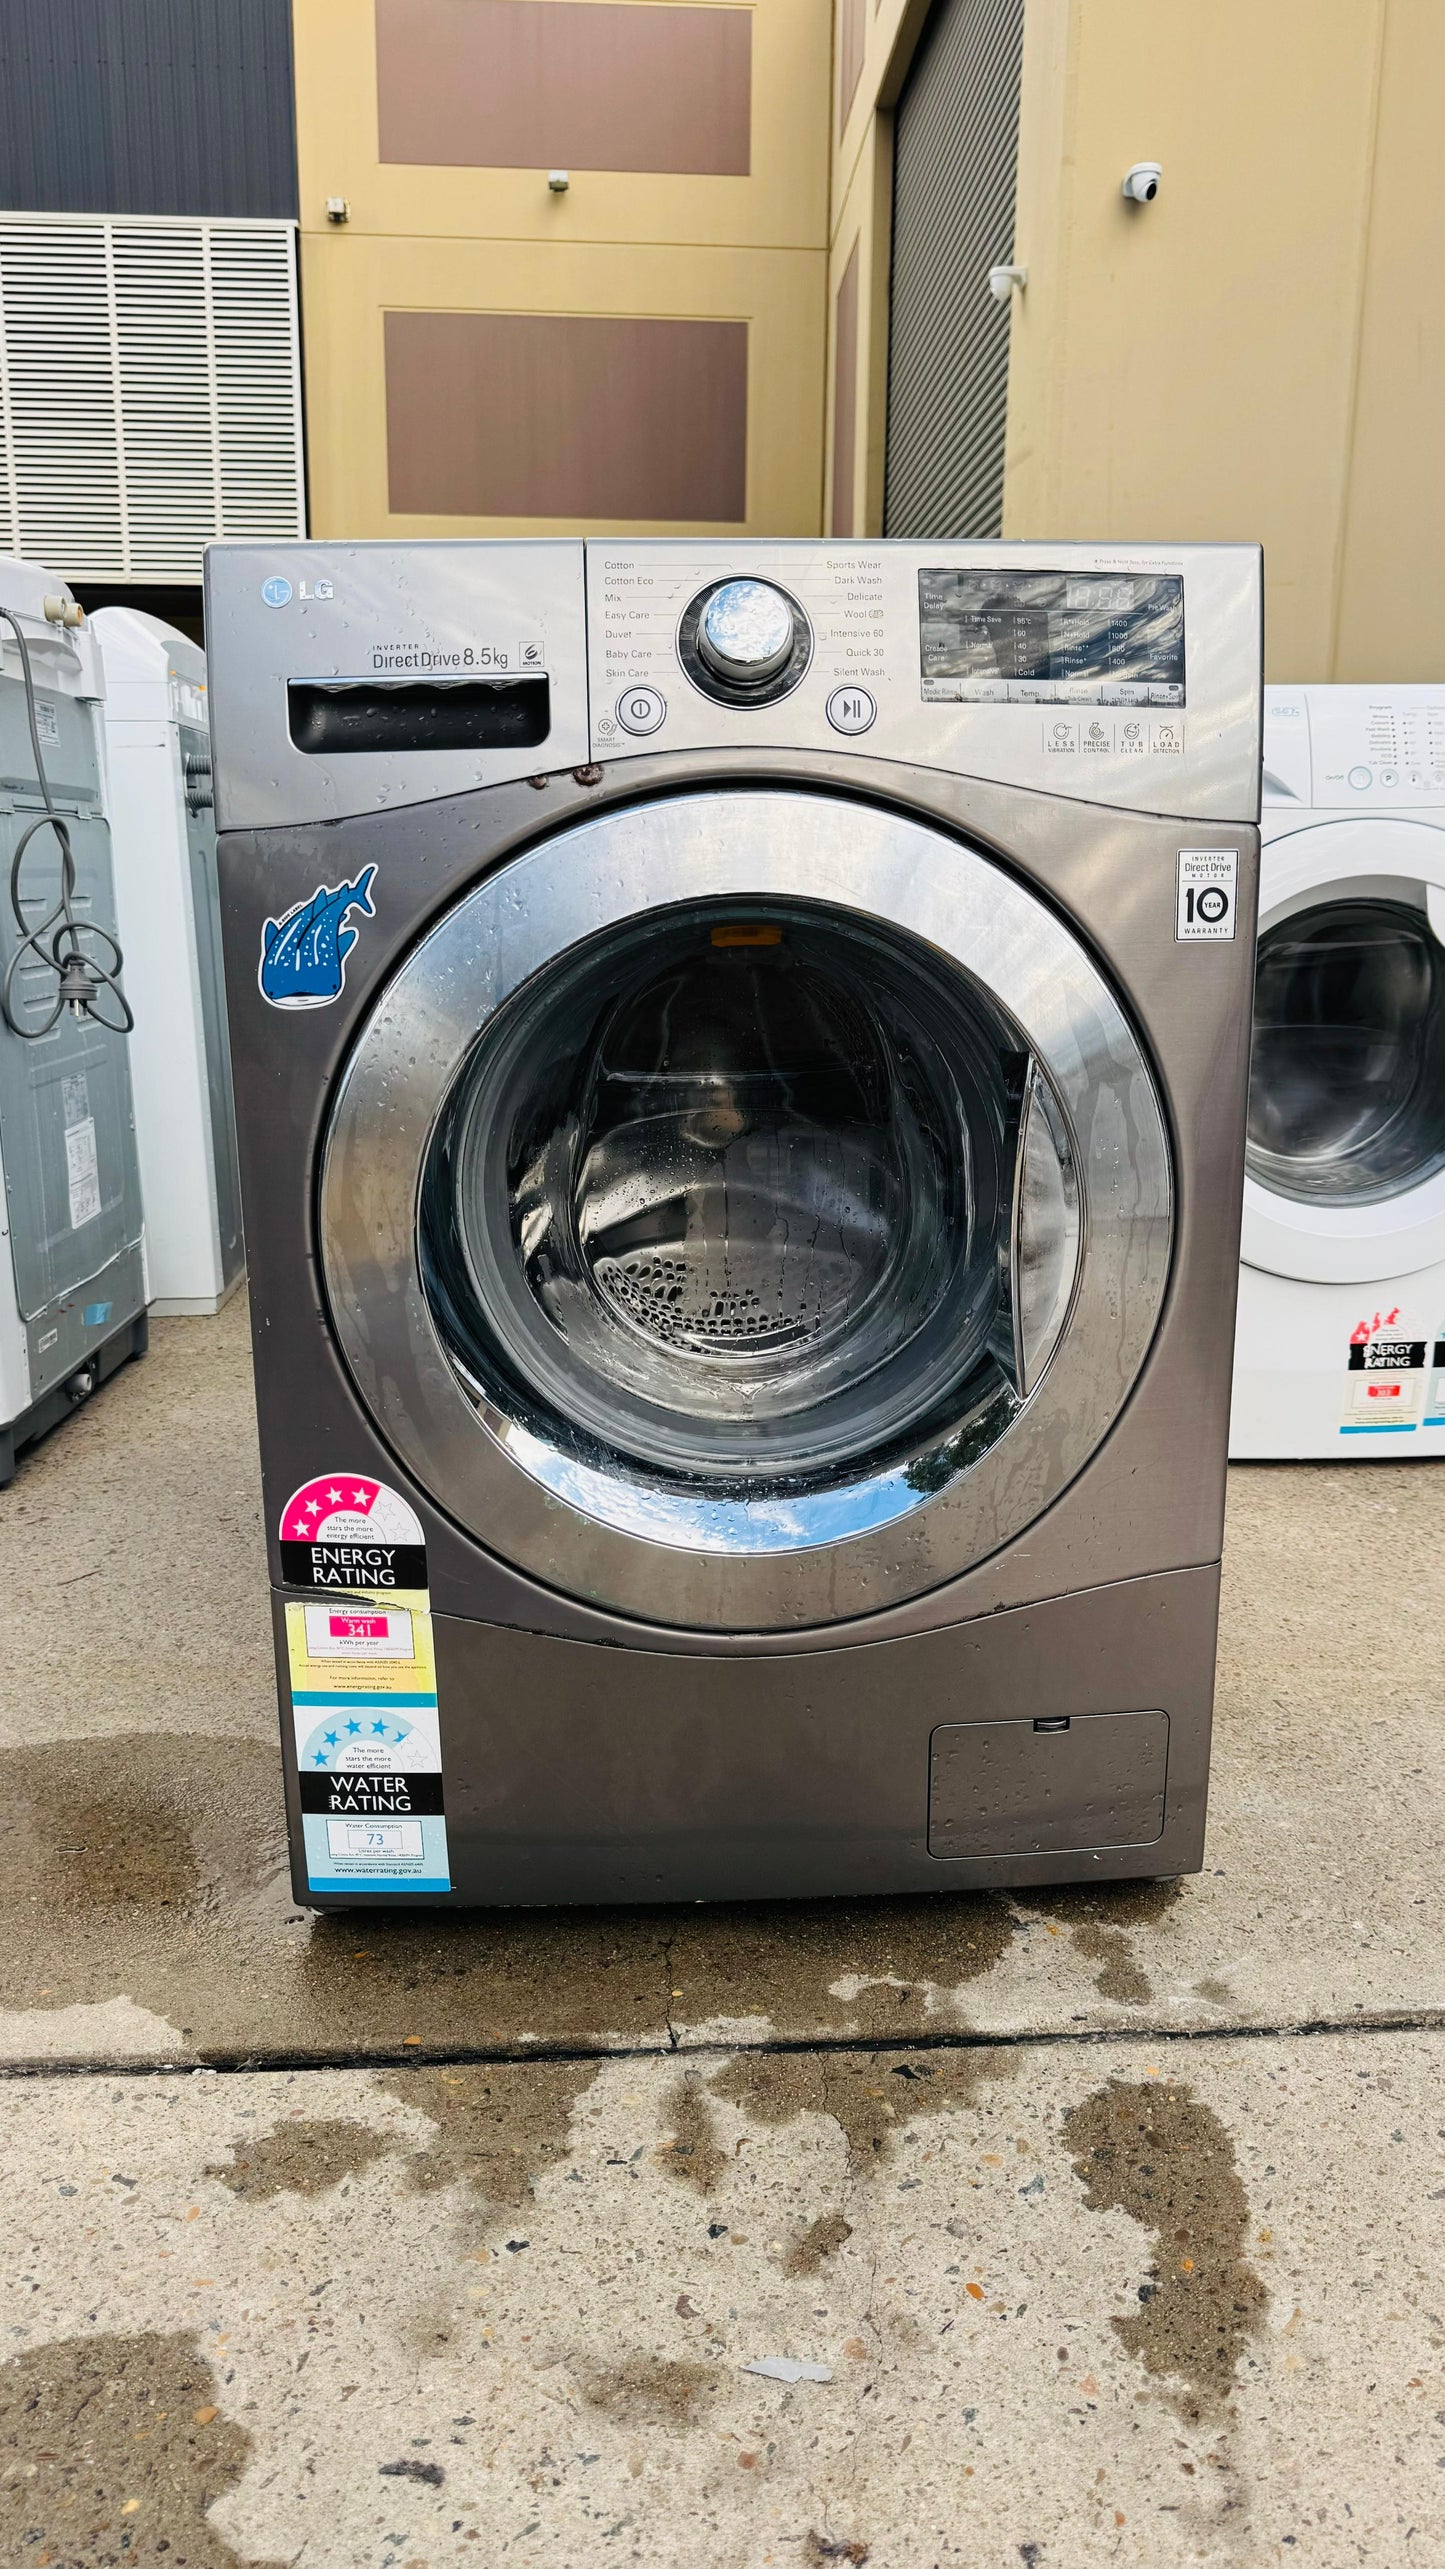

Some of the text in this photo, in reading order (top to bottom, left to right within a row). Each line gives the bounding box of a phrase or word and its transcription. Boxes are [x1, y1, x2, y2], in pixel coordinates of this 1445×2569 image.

[604, 561, 634, 569] Cotton
[826, 560, 881, 569] Sports Wear
[604, 577, 654, 585] Cotton Eco
[834, 576, 882, 584] Dark Wash
[300, 579, 334, 600] LG
[605, 594, 622, 602] Mix
[924, 602, 944, 610] Delay
[605, 611, 650, 620] Easy Care
[844, 610, 867, 618] Wool
[605, 630, 632, 638] Duvet
[830, 629, 884, 638] Intensive 60
[606, 650, 652, 659] Baby Care
[846, 648, 871, 656] Quick
[606, 669, 649, 677] Skin Care
[834, 668, 885, 676] Silent Wash
[1185, 863, 1232, 872] Direct Drive
[1186, 887, 1228, 923] 10
[311, 1548, 396, 1566] ENERGY
[313, 1568, 396, 1586] RATING
[348, 1624, 371, 1636] 341
[330, 1776, 408, 1793] WATER
[331, 1795, 411, 1812] RATING
[366, 1834, 384, 1845] 73
